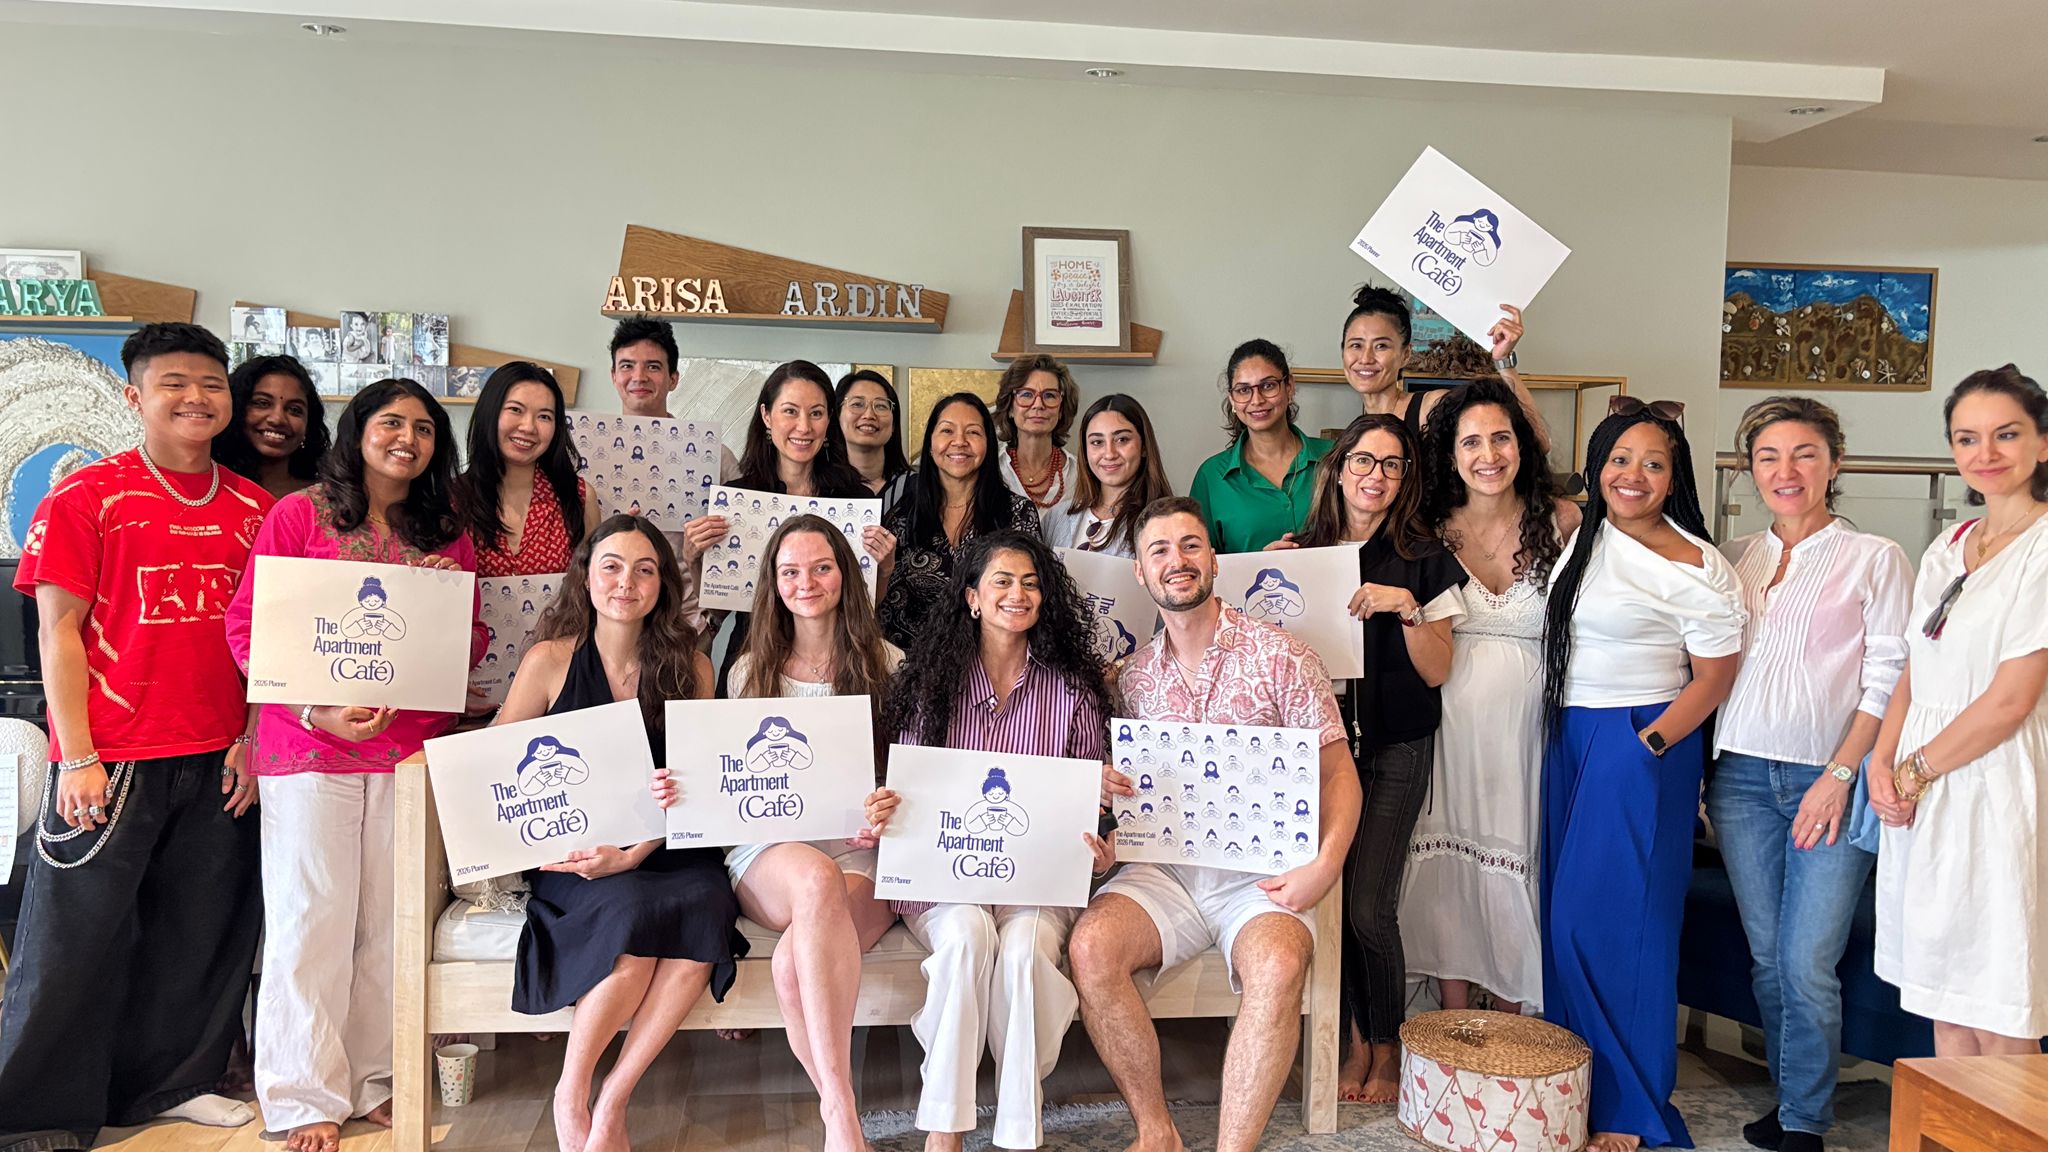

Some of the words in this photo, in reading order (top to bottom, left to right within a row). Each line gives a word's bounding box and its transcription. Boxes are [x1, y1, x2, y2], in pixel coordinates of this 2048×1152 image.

[1425, 210, 1445, 233] The
[1413, 226, 1467, 271] Apartment
[1058, 260, 1093, 270] HOME
[1411, 251, 1463, 296] (Café)
[602, 275, 729, 314] ARISA
[779, 280, 925, 319] ARDIN
[1099, 597, 1116, 615] The
[314, 617, 338, 635] The
[313, 635, 382, 656] Apartment
[330, 657, 395, 686] (Café)
[719, 754, 744, 773] The
[490, 782, 518, 802] The
[719, 772, 790, 797] Apartment
[497, 790, 569, 824] Apartment
[738, 792, 804, 823] (Café)
[520, 808, 588, 847] (Café)
[940, 810, 962, 830] The
[685, 831, 704, 839] Planner
[937, 830, 1005, 853] Apartment
[952, 853, 1016, 883] (Café)
